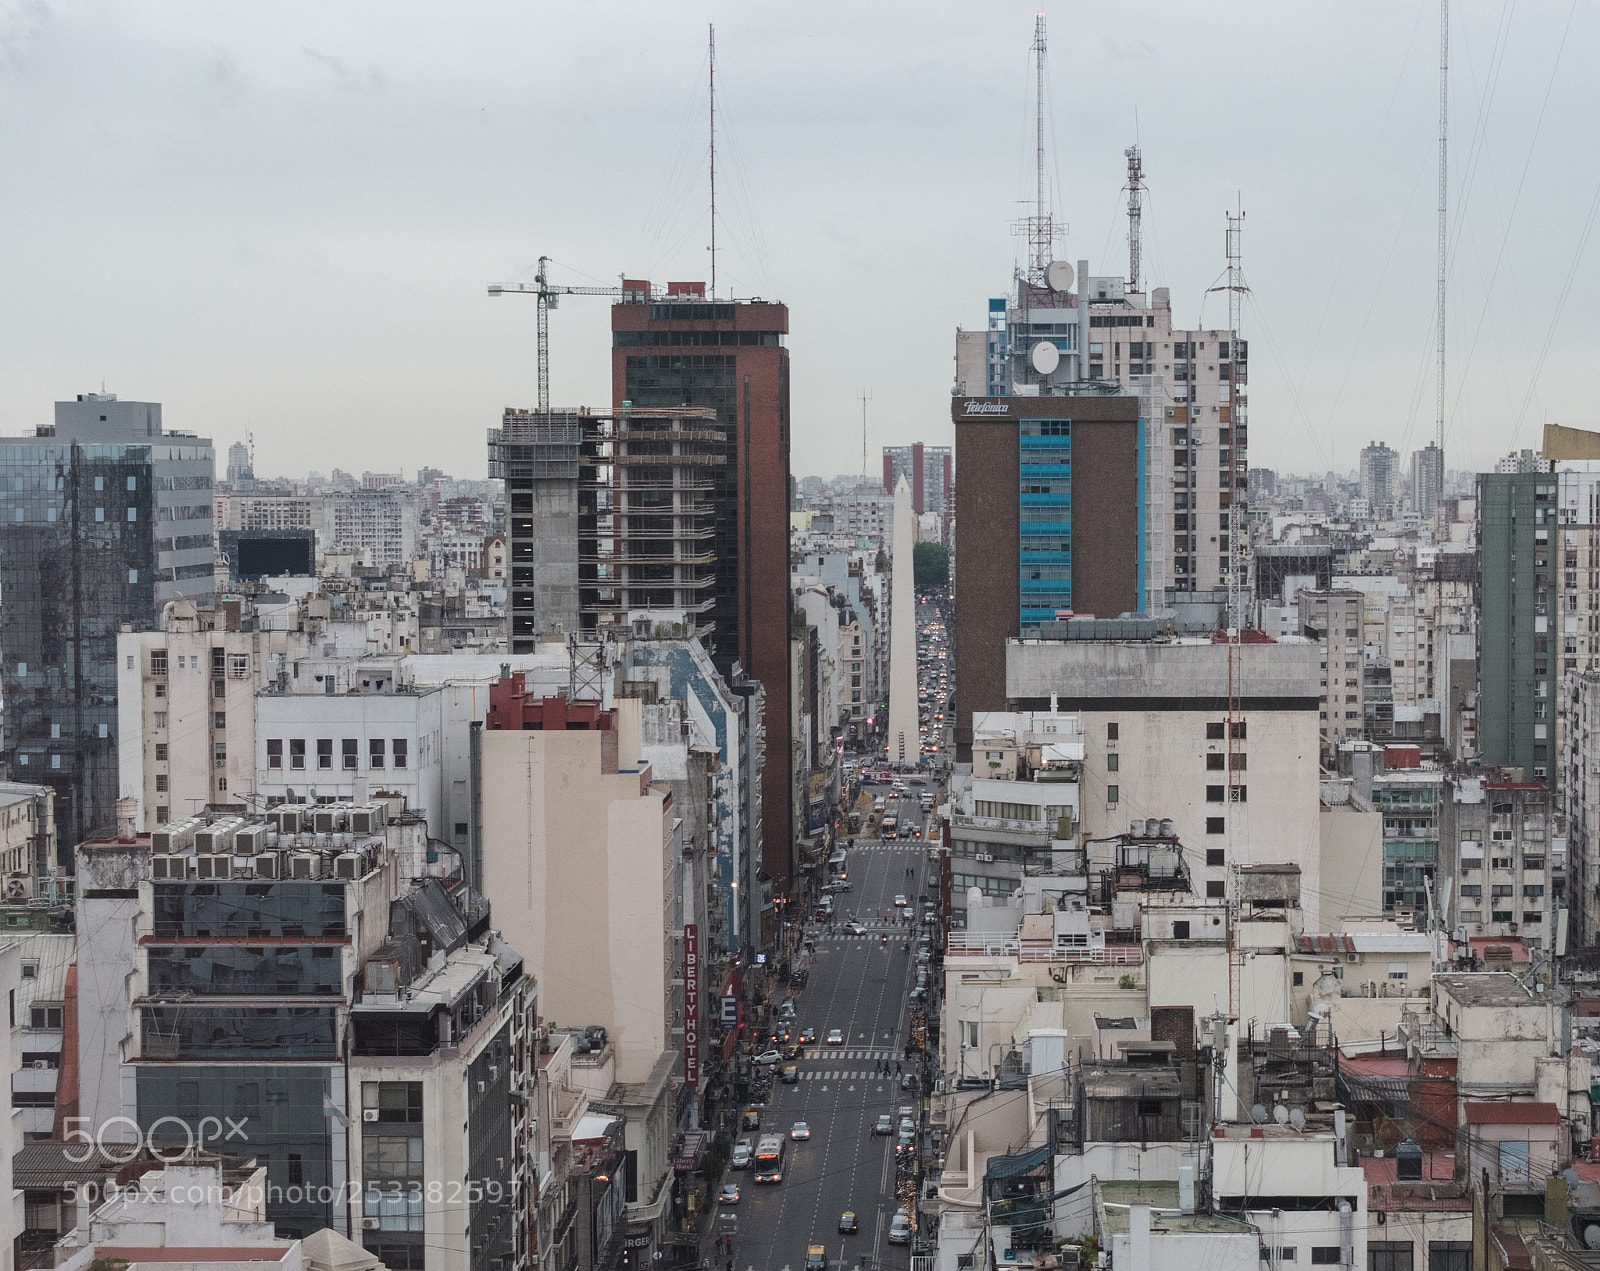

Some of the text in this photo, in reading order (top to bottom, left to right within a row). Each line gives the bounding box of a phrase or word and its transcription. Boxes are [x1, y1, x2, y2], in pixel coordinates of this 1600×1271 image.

[687, 927, 696, 1082] LIBERTY HOTEL
[721, 997, 736, 1020] E
